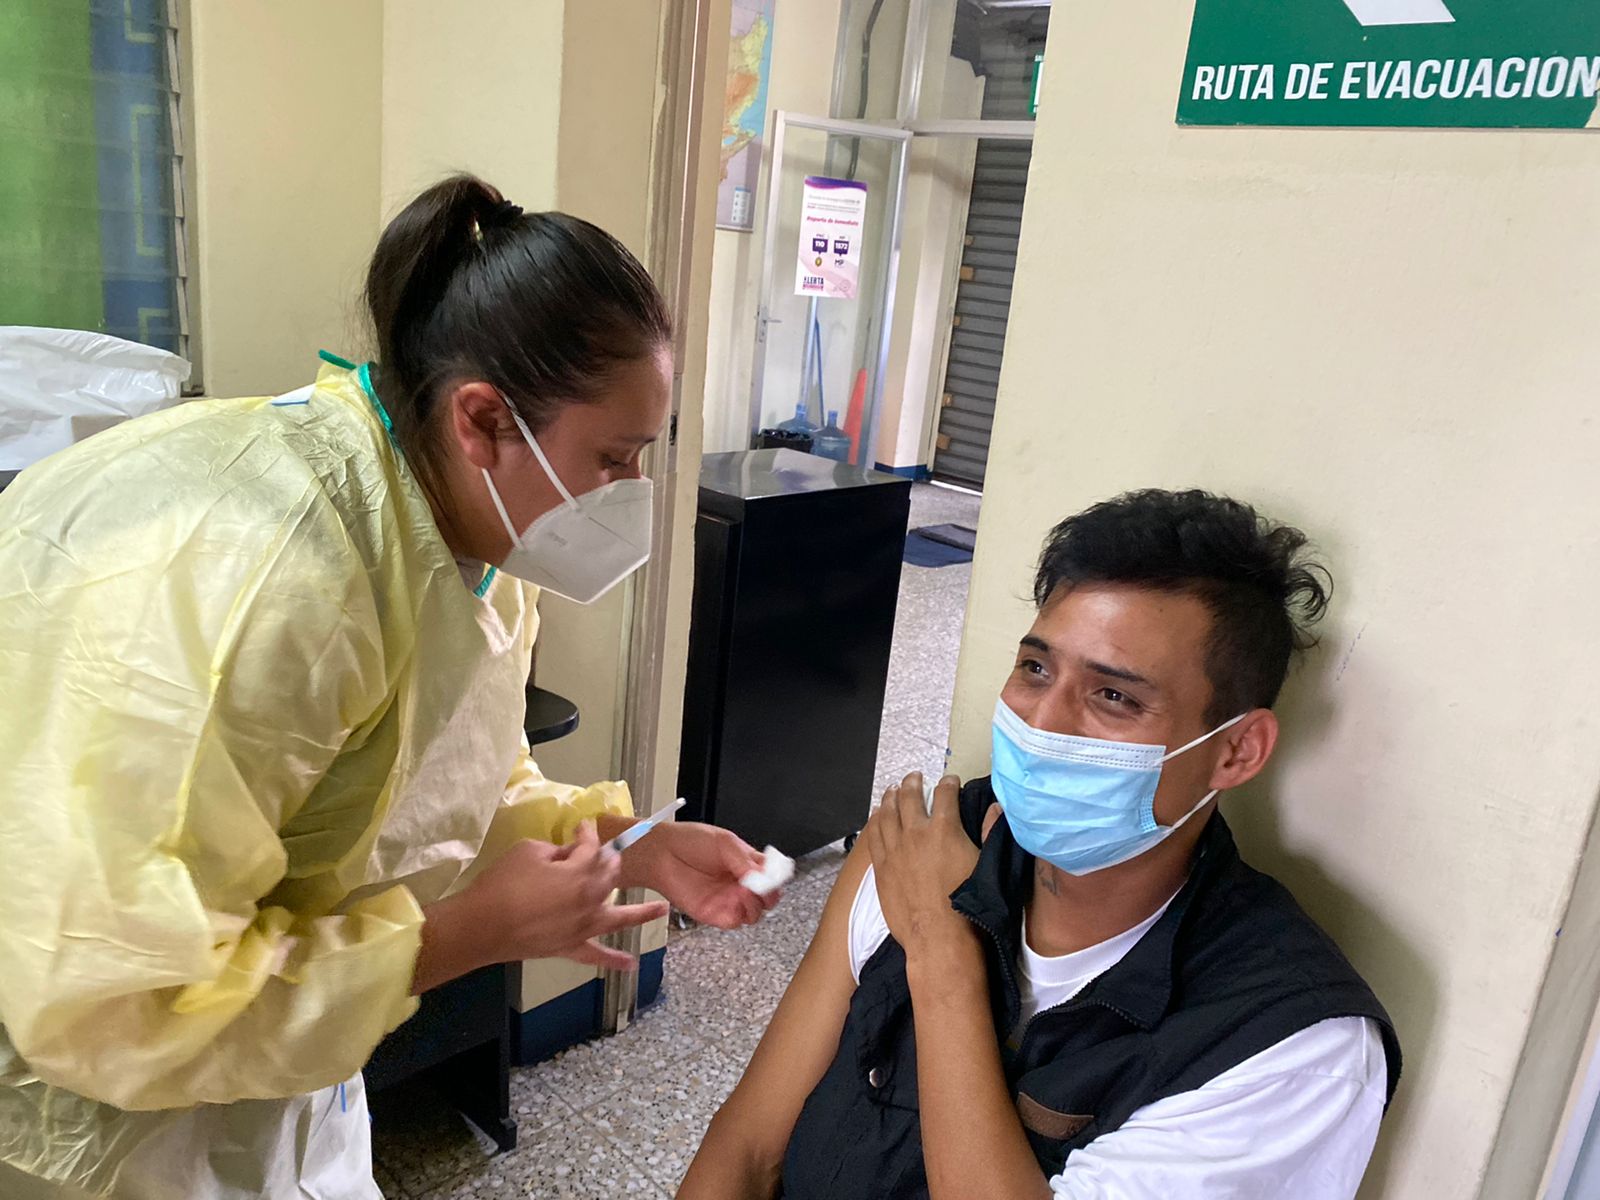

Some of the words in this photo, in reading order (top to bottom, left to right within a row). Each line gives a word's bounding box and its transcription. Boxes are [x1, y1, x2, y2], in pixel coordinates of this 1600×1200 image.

[1192, 64, 1274, 101] RUTA
[1284, 62, 1334, 100] DE
[1339, 56, 1600, 99] EVACUACION
[803, 276, 824, 285] ALERTA
